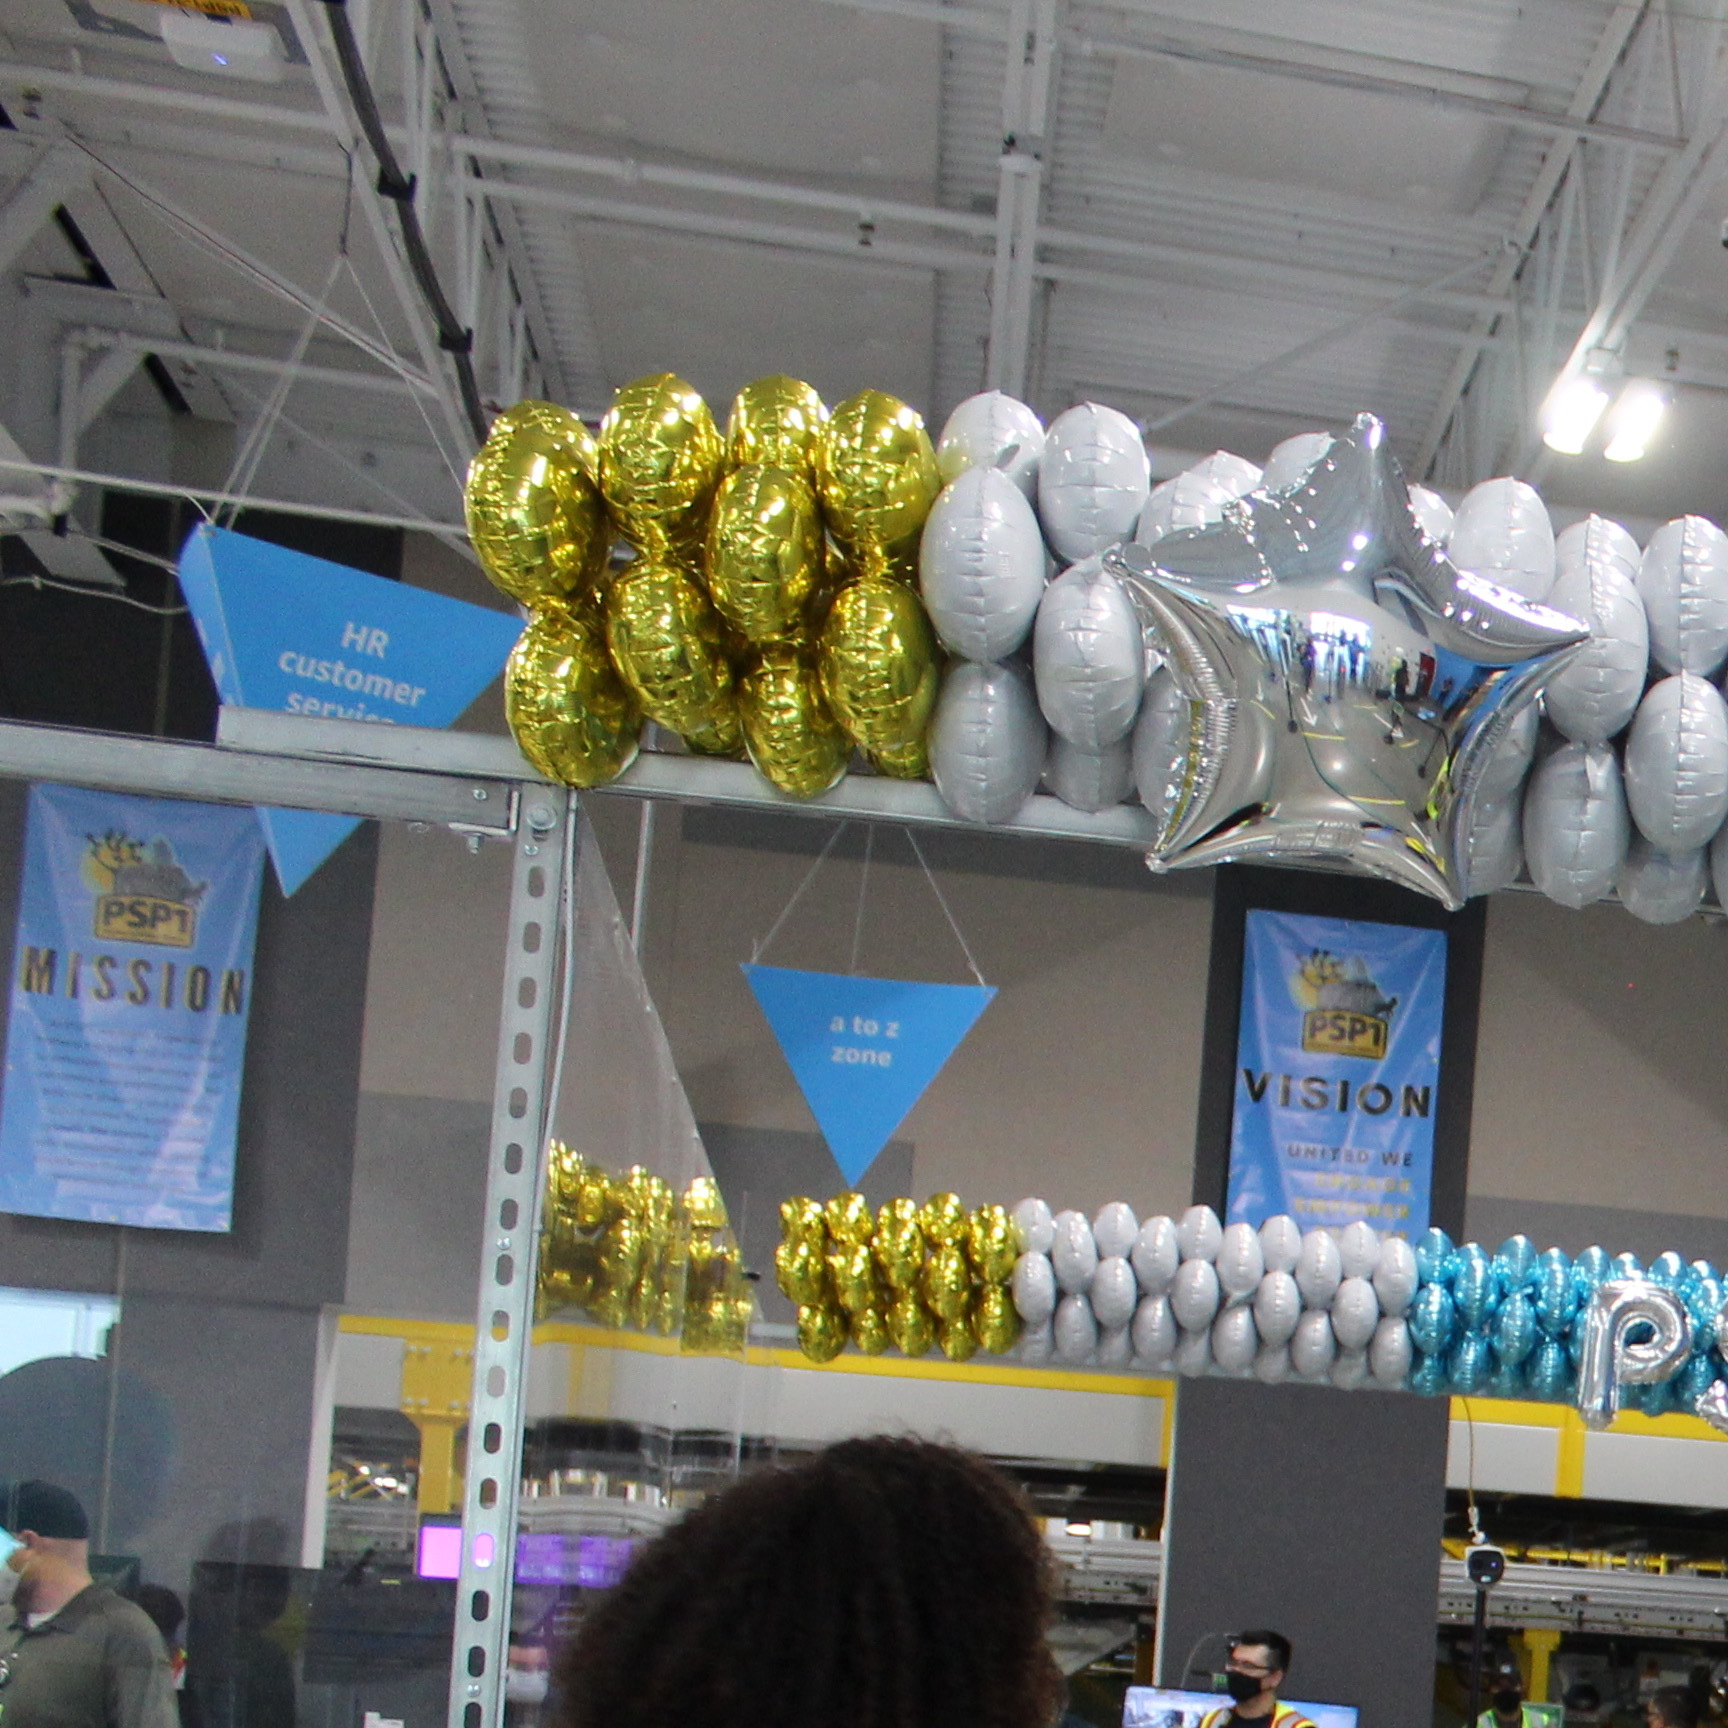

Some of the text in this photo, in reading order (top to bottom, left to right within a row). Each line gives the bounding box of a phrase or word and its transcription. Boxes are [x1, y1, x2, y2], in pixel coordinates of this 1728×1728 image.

[341, 621, 391, 659] HR
[278, 651, 426, 706] customer
[103, 899, 190, 932] PSP1
[20, 945, 245, 1015] MISSION
[829, 1016, 900, 1038] a to z
[1310, 1013, 1381, 1047] PSP1
[831, 1046, 893, 1067] zone
[1243, 1068, 1431, 1118] VISION
[1287, 1144, 1413, 1167] UNITED WE
